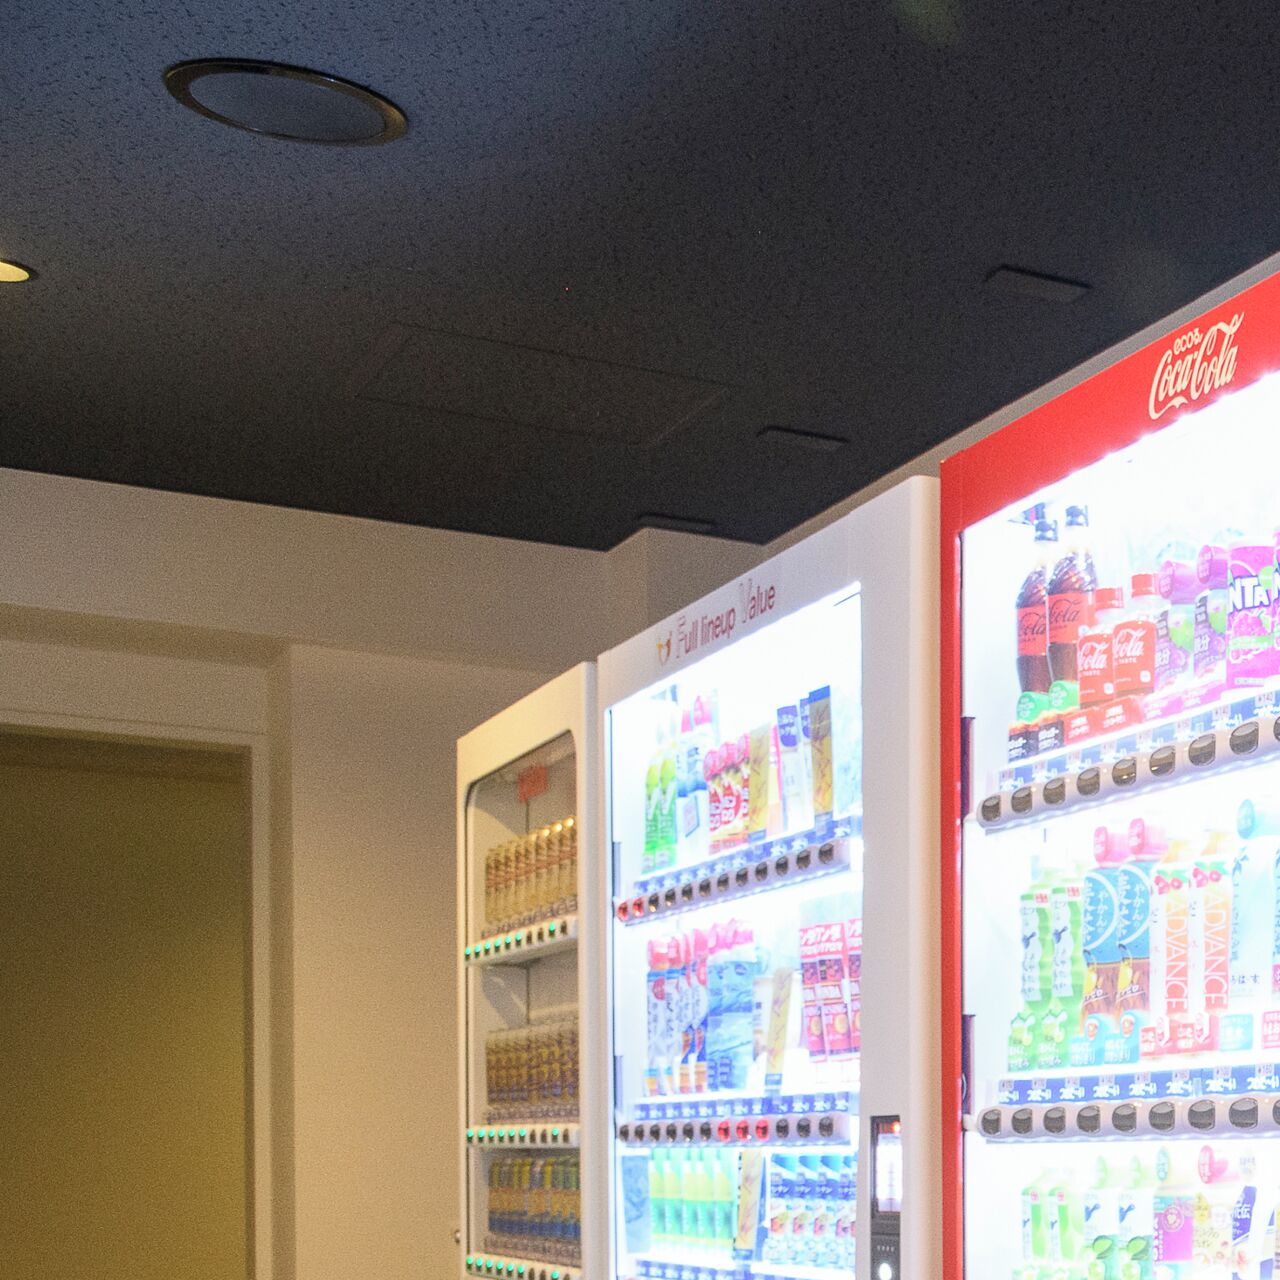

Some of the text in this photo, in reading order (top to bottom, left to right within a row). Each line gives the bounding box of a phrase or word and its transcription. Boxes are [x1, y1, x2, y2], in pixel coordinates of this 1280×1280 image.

[1148, 312, 1245, 420] Coca-Cola
[1228, 577, 1270, 612] NTA
[1165, 902, 1188, 1014] ADVANCE
[1203, 892, 1228, 1007] ADVANCE
